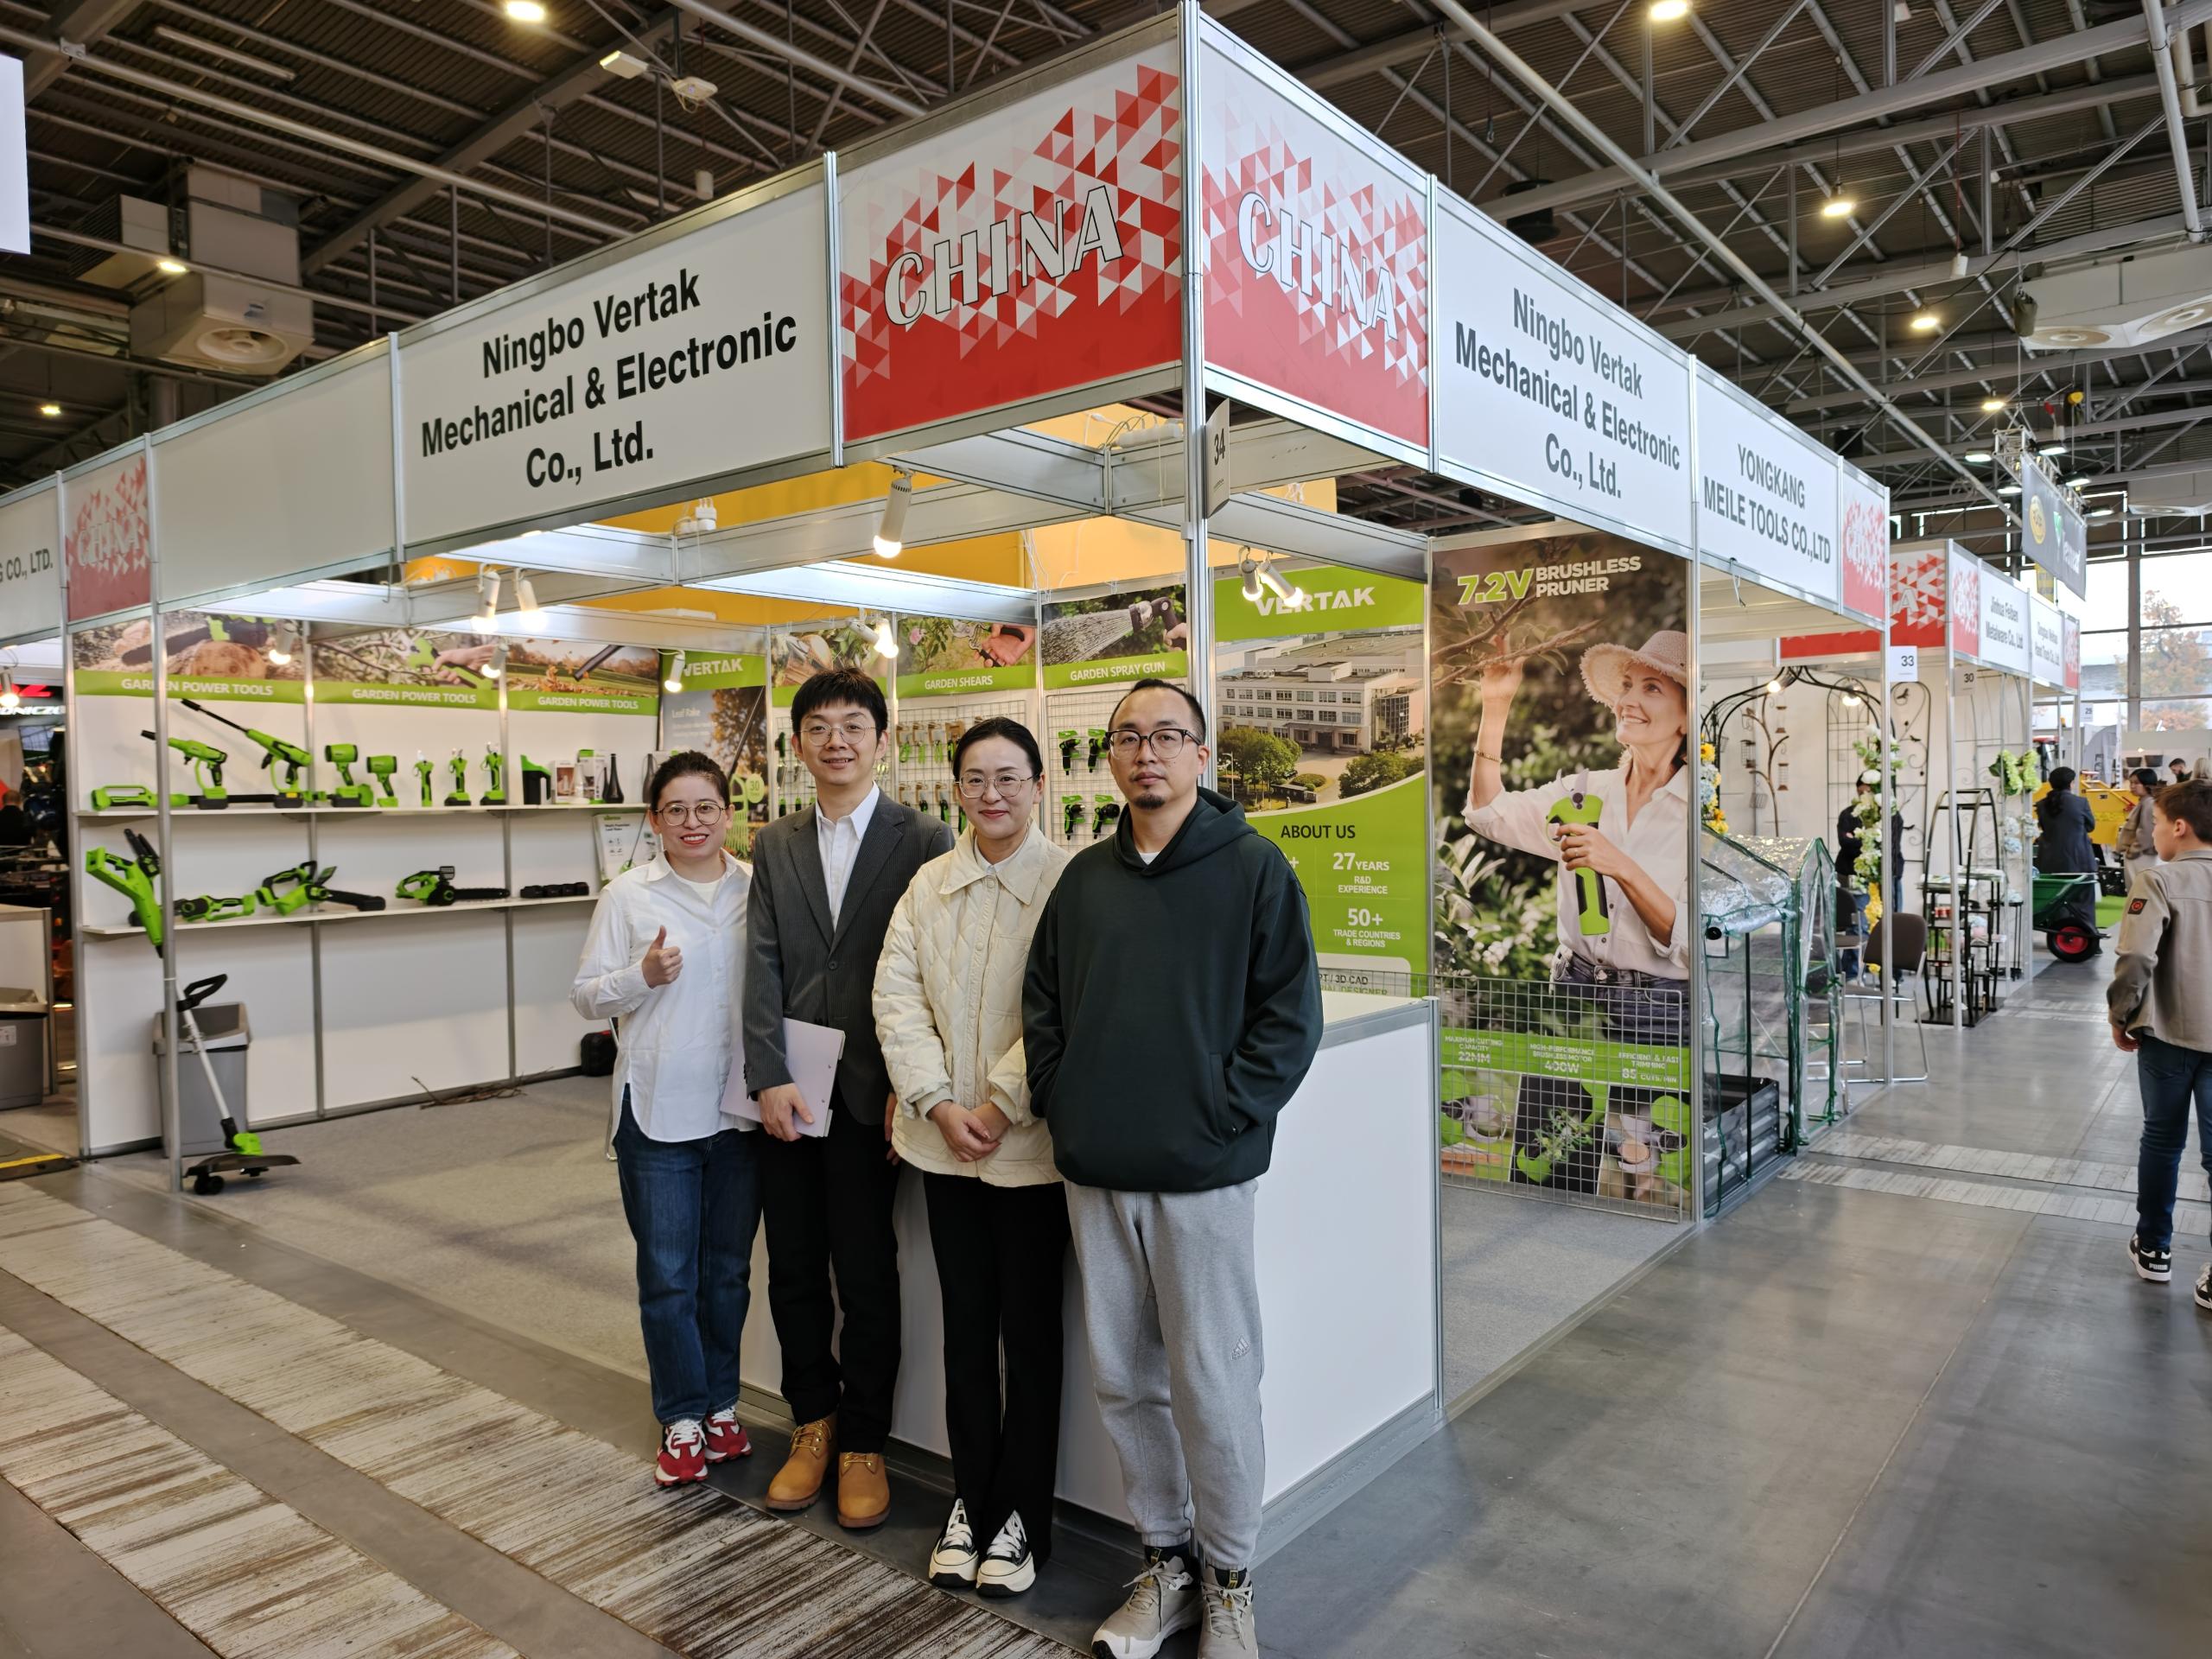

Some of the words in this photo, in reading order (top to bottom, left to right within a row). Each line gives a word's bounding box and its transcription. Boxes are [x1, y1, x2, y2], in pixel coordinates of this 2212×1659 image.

[883, 184, 1124, 327] CHINA
[1237, 191, 1398, 341] CHINA
[483, 316, 584, 378] Ningbo
[593, 268, 701, 339] Vertak
[1513, 288, 1585, 365] Ningbo
[1590, 335, 1643, 400] Vertak
[422, 375, 574, 458] Mechanical
[585, 366, 607, 410] &
[617, 311, 797, 400] Electronic
[1455, 321, 1578, 423] Mechanical
[1584, 391, 1597, 431] &
[1602, 401, 1680, 471] Electronic
[526, 447, 582, 489] Co.,
[593, 420, 654, 474] Ltd.
[1214, 428, 1226, 466] 34
[1546, 432, 1583, 490] Co.,
[1588, 451, 1622, 499] Ltd.
[1738, 443, 1805, 510] YONGKANG
[1704, 475, 1746, 525] MEILE
[1749, 500, 1789, 546] TOOLS
[6, 556, 28, 581] CO.,
[30, 548, 54, 575] LTD.
[1457, 568, 1535, 606] 7.2V
[1535, 556, 1642, 582] BRUSHLESS
[1535, 576, 1610, 598] PRUNER
[1255, 587, 1376, 617] VERTAK
[683, 658, 743, 677] VERTAK
[1071, 668, 1109, 681] GARDEN
[1109, 664, 1141, 677] SPRAY
[1142, 661, 1166, 674] GUN
[1901, 655, 1915, 667] 33
[925, 679, 957, 690] GARDEN
[959, 675, 994, 687] SHEARS
[1964, 672, 1975, 683] 30
[182, 682, 230, 694] POWER
[232, 684, 273, 696] TOOLS
[352, 689, 399, 702] GARDEN
[402, 691, 441, 703] POWER
[442, 692, 476, 704] TOOLS
[538, 696, 577, 708] GARDEN
[579, 698, 611, 709] POWER
[612, 699, 639, 710] TOOLS
[1281, 824, 1332, 839] ABOUT
[1336, 824, 1356, 839] US
[1332, 852, 1356, 870] 27
[1356, 861, 1390, 871] YEARS
[1338, 884, 1389, 895] EXPERIENCE
[1354, 875, 1372, 884] R&D
[1348, 907, 1383, 927] 50+
[1332, 928, 1357, 938] TRADE
[1358, 930, 1402, 940] COUNTRIES
[1352, 938, 1386, 948] REGIONS
[1335, 974, 1347, 984] 3D
[1349, 976, 1369, 985] CAD
